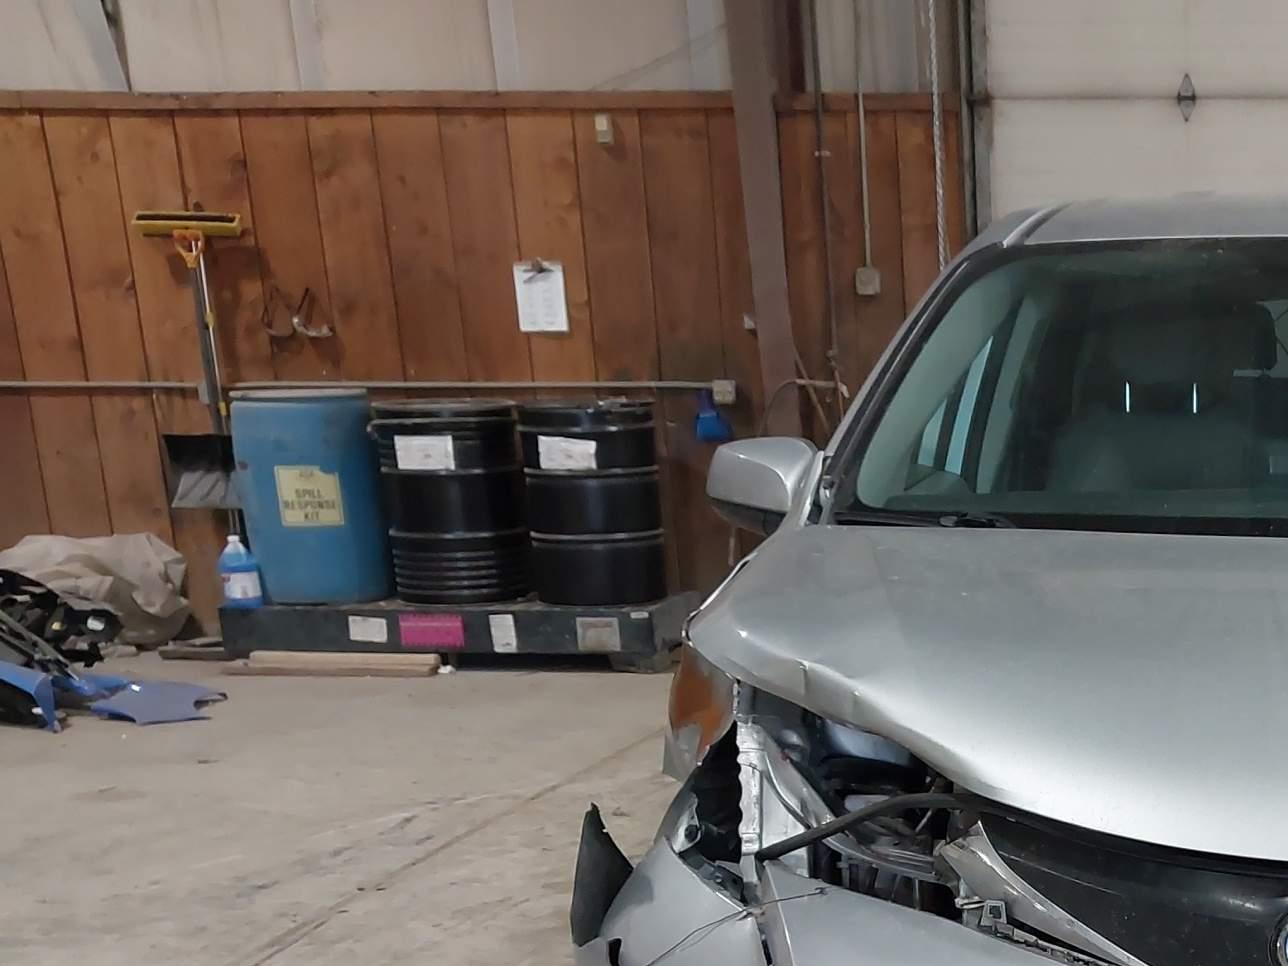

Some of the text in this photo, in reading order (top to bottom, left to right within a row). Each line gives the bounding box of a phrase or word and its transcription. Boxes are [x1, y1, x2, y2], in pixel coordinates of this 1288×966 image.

[295, 488, 322, 499] SPILL
[283, 499, 336, 511] RESPONSE
[304, 511, 320, 521] KIT
